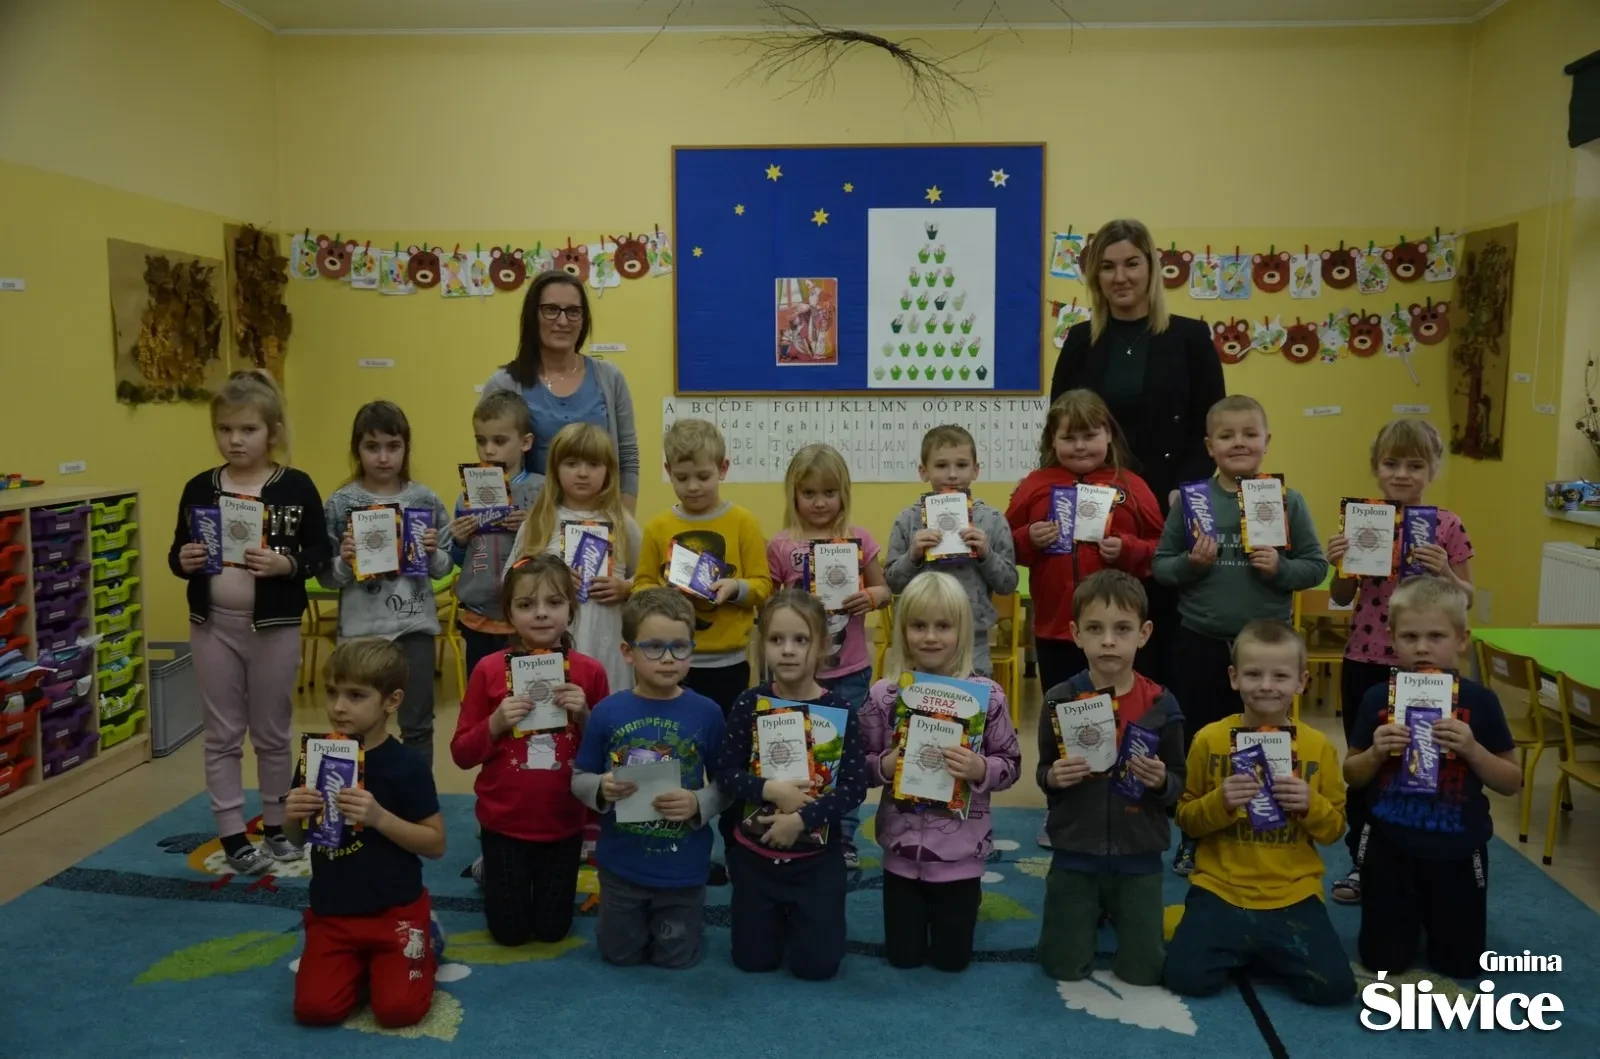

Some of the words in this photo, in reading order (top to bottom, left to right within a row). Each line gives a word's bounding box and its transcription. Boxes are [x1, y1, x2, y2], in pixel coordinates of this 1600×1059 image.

[469, 470, 498, 479] Dyplom
[1080, 485, 1110, 496] Dyplom
[1247, 482, 1276, 491] Dyplom
[224, 499, 257, 513] Dyplom
[930, 496, 961, 506] Dyplom
[358, 512, 389, 523] Dyplom
[1056, 496, 1073, 536] Milka
[1189, 492, 1212, 532] Milka
[1352, 506, 1388, 517] Dyplom
[198, 516, 221, 557] Milka
[571, 527, 602, 536] Dylom
[820, 546, 852, 556] Dyplom
[518, 657, 556, 670] Dyplom
[1404, 675, 1444, 686] Dyplom
[909, 685, 974, 704] KOLOROWANKA
[1063, 699, 1104, 715] Dyplom
[762, 716, 796, 729] Dyplom
[916, 719, 955, 735] Dyplom
[1244, 734, 1283, 745] Dyplom
[1413, 719, 1439, 770] Milka
[313, 742, 351, 755] Dyplom
